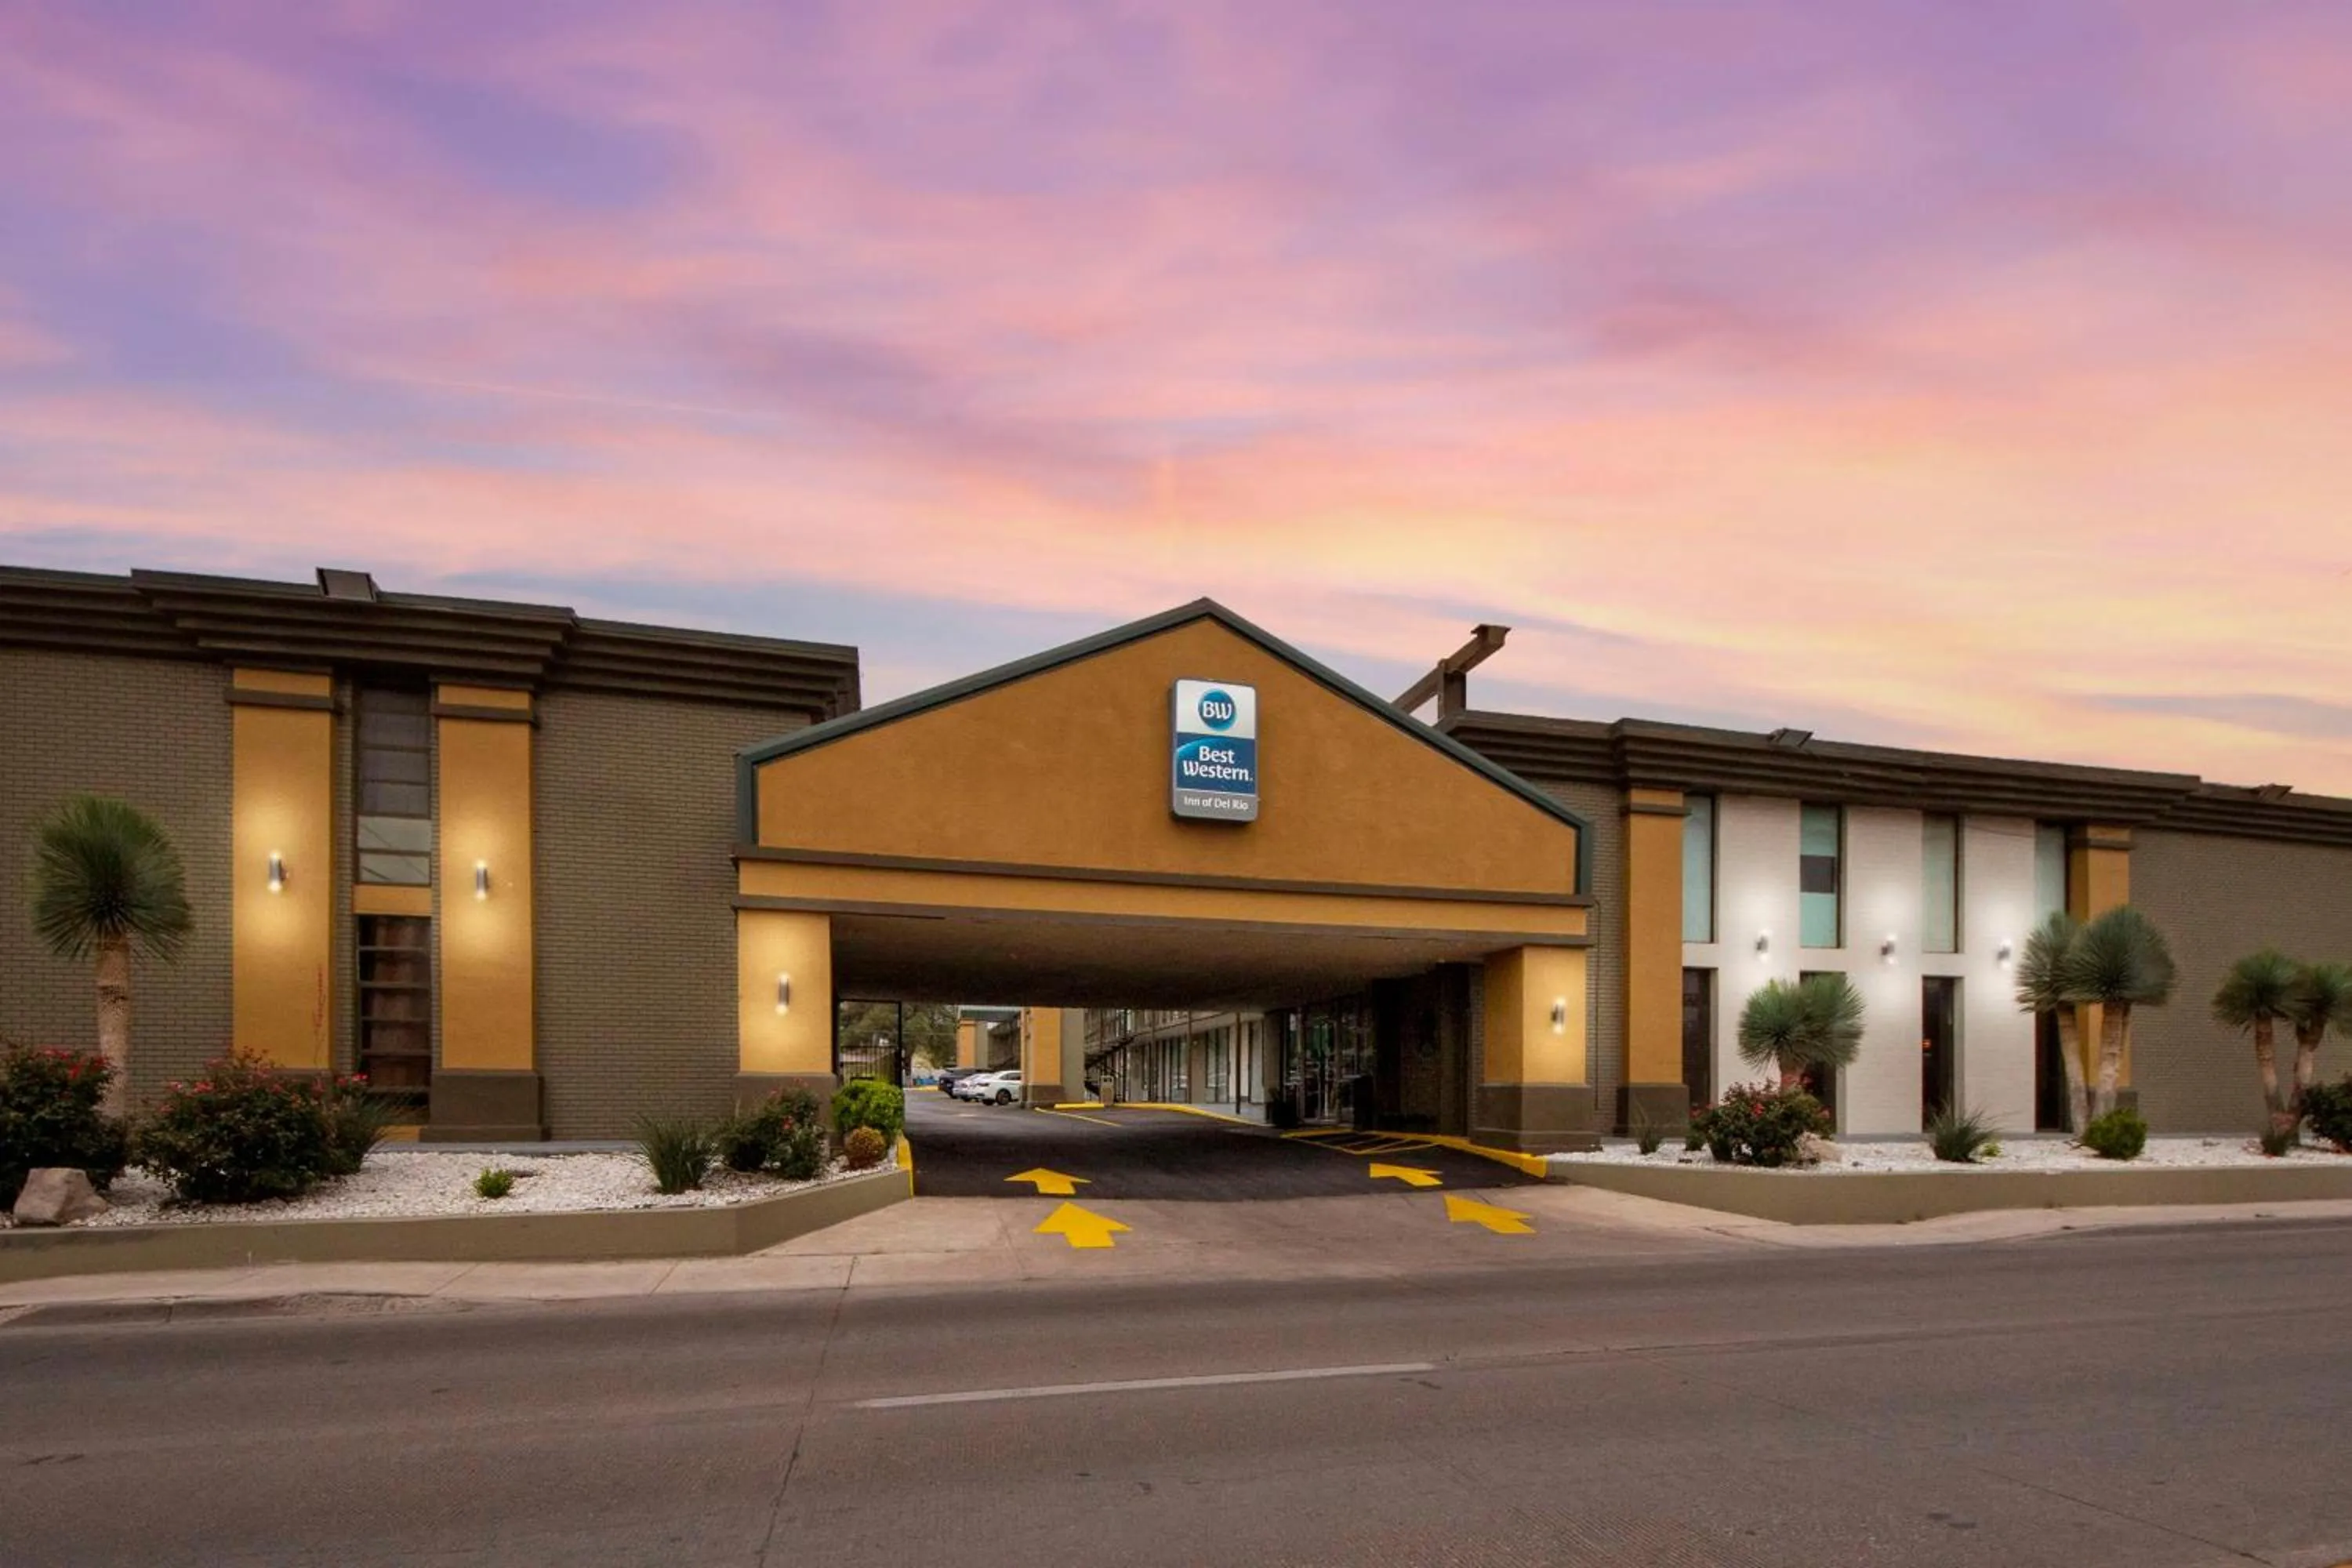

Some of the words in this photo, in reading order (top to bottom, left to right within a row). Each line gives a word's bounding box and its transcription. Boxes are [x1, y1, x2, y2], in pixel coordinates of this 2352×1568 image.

[1203, 700, 1232, 720] BW
[1199, 746, 1235, 764] Best
[1184, 796, 1200, 806] Inn
[1202, 798, 1212, 807] of
[1214, 798, 1230, 808] Del
[1232, 800, 1248, 811] Rio
